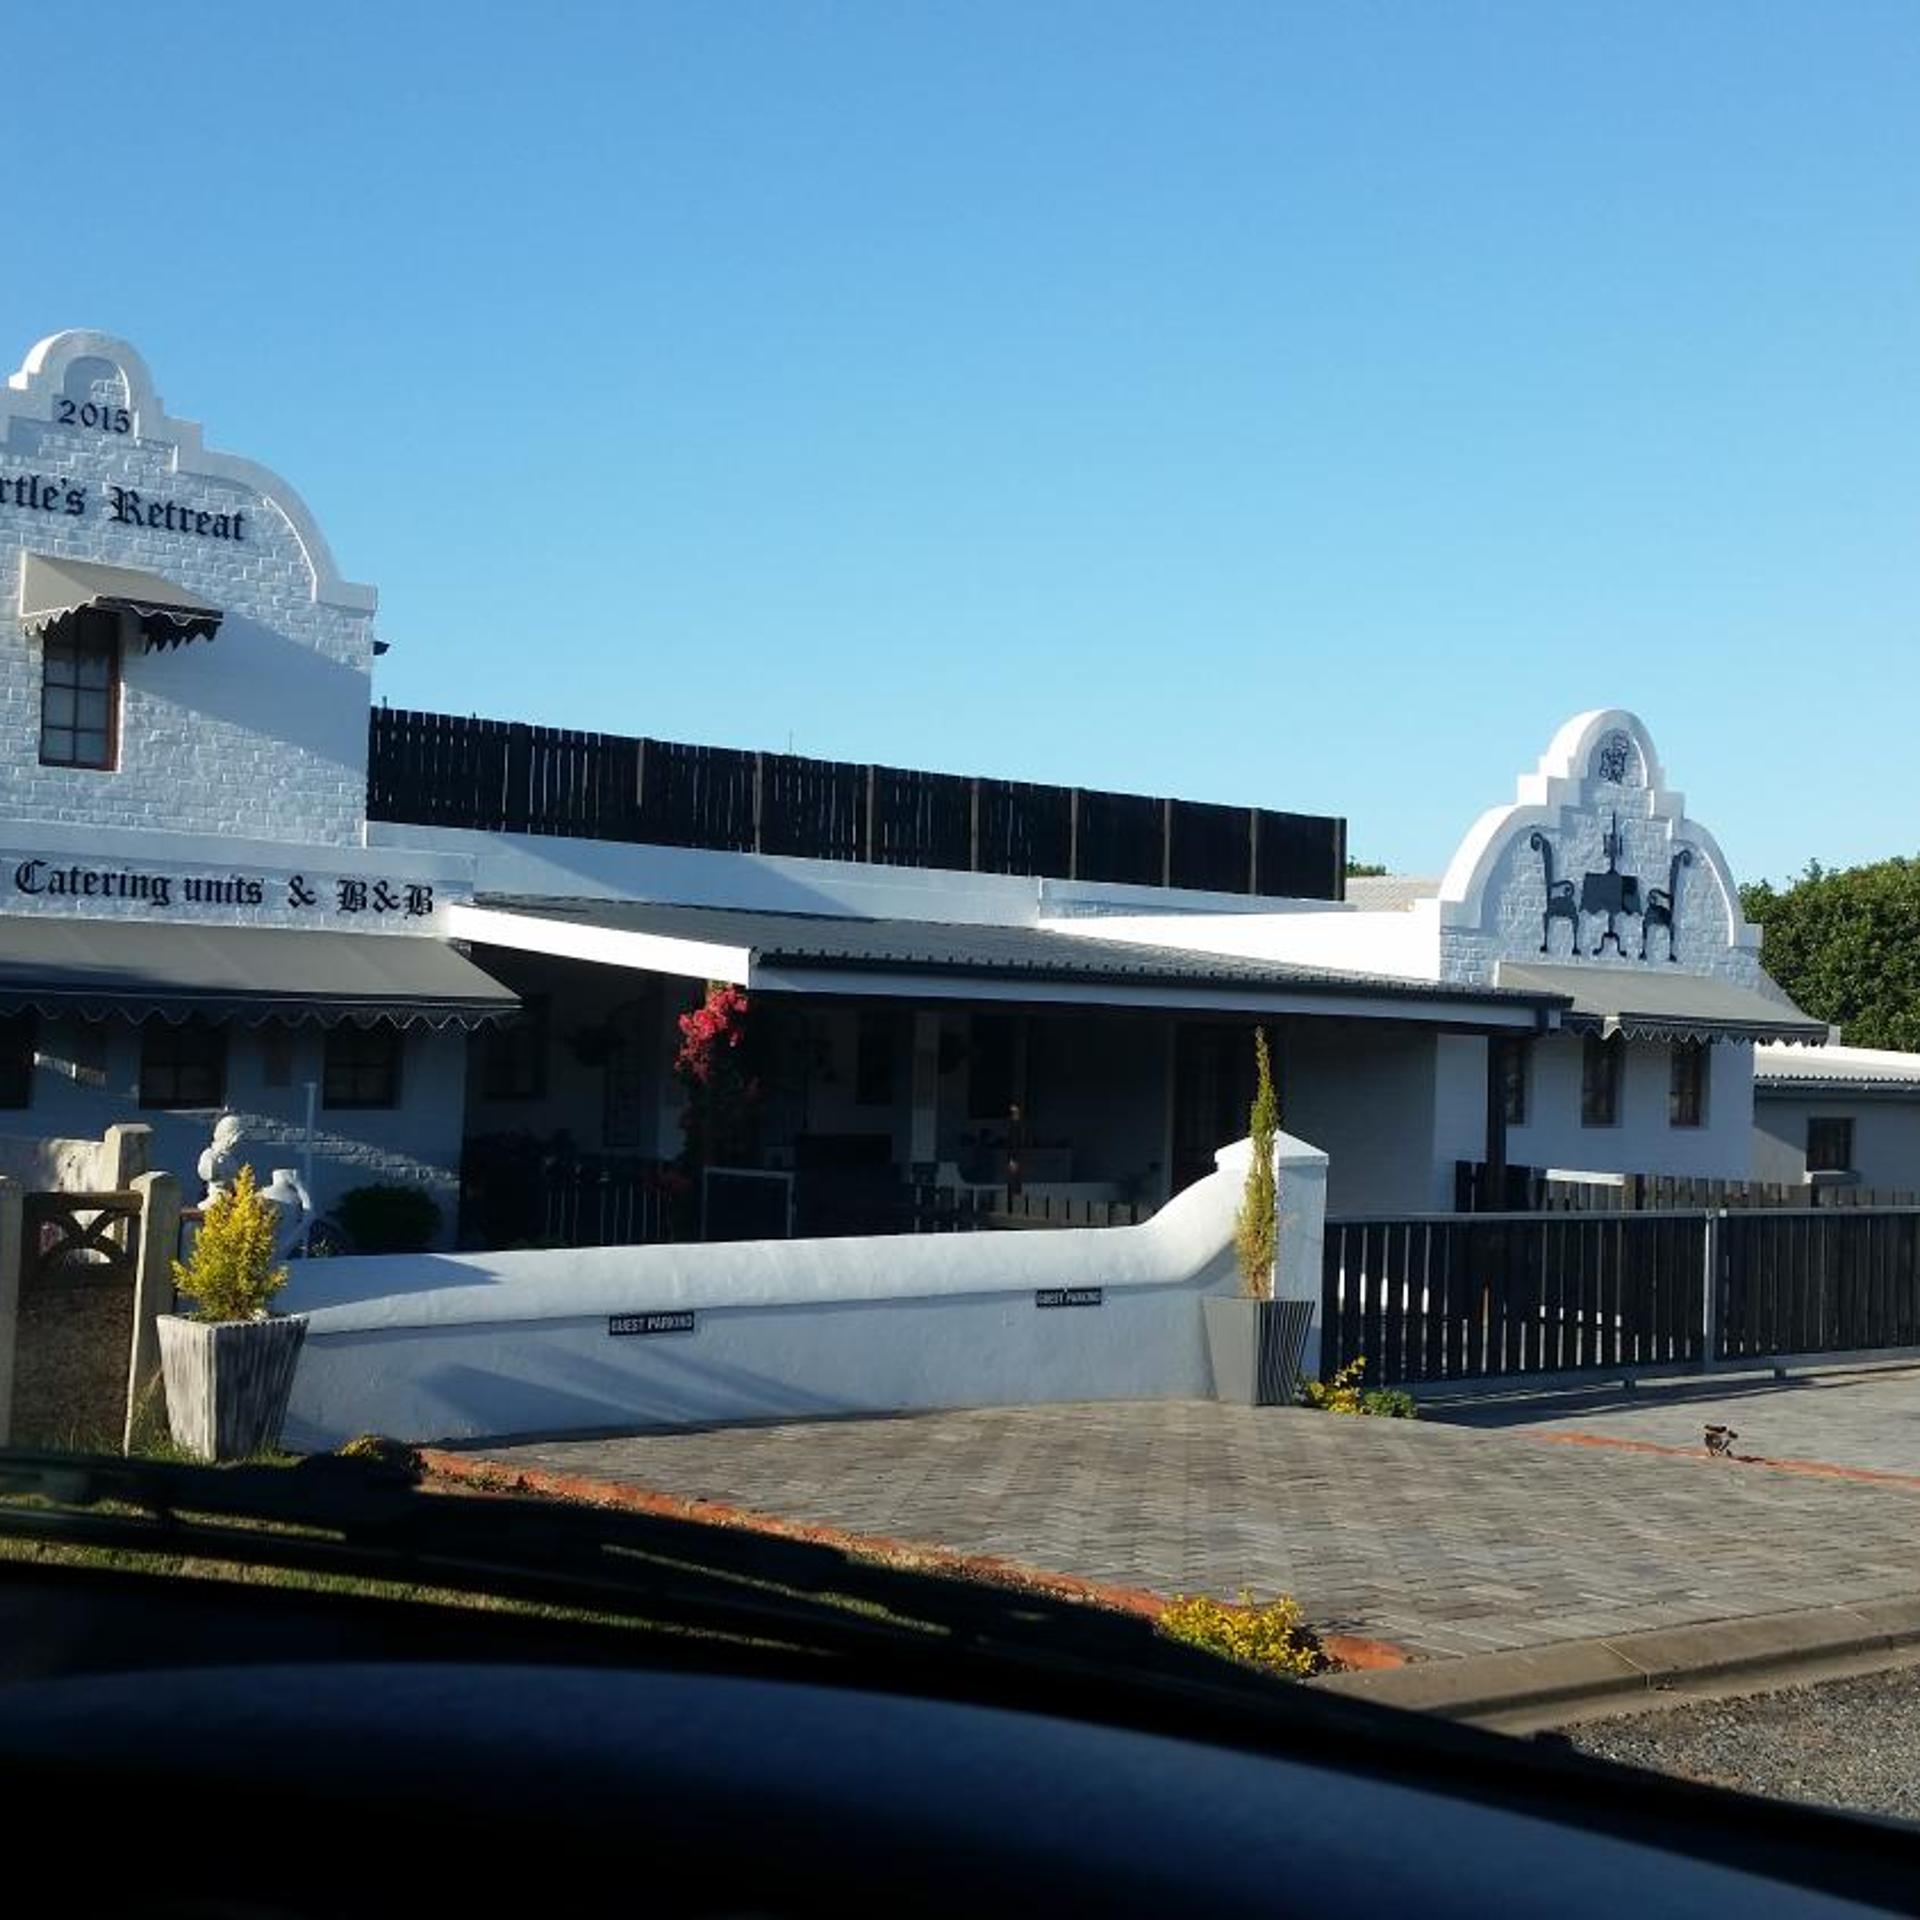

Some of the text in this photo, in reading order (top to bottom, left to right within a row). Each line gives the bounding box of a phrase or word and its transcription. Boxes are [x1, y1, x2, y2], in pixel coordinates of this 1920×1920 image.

[59, 400, 131, 433] 2015
[108, 486, 245, 540] Retreat
[15, 859, 434, 920] Catering units & B&B
